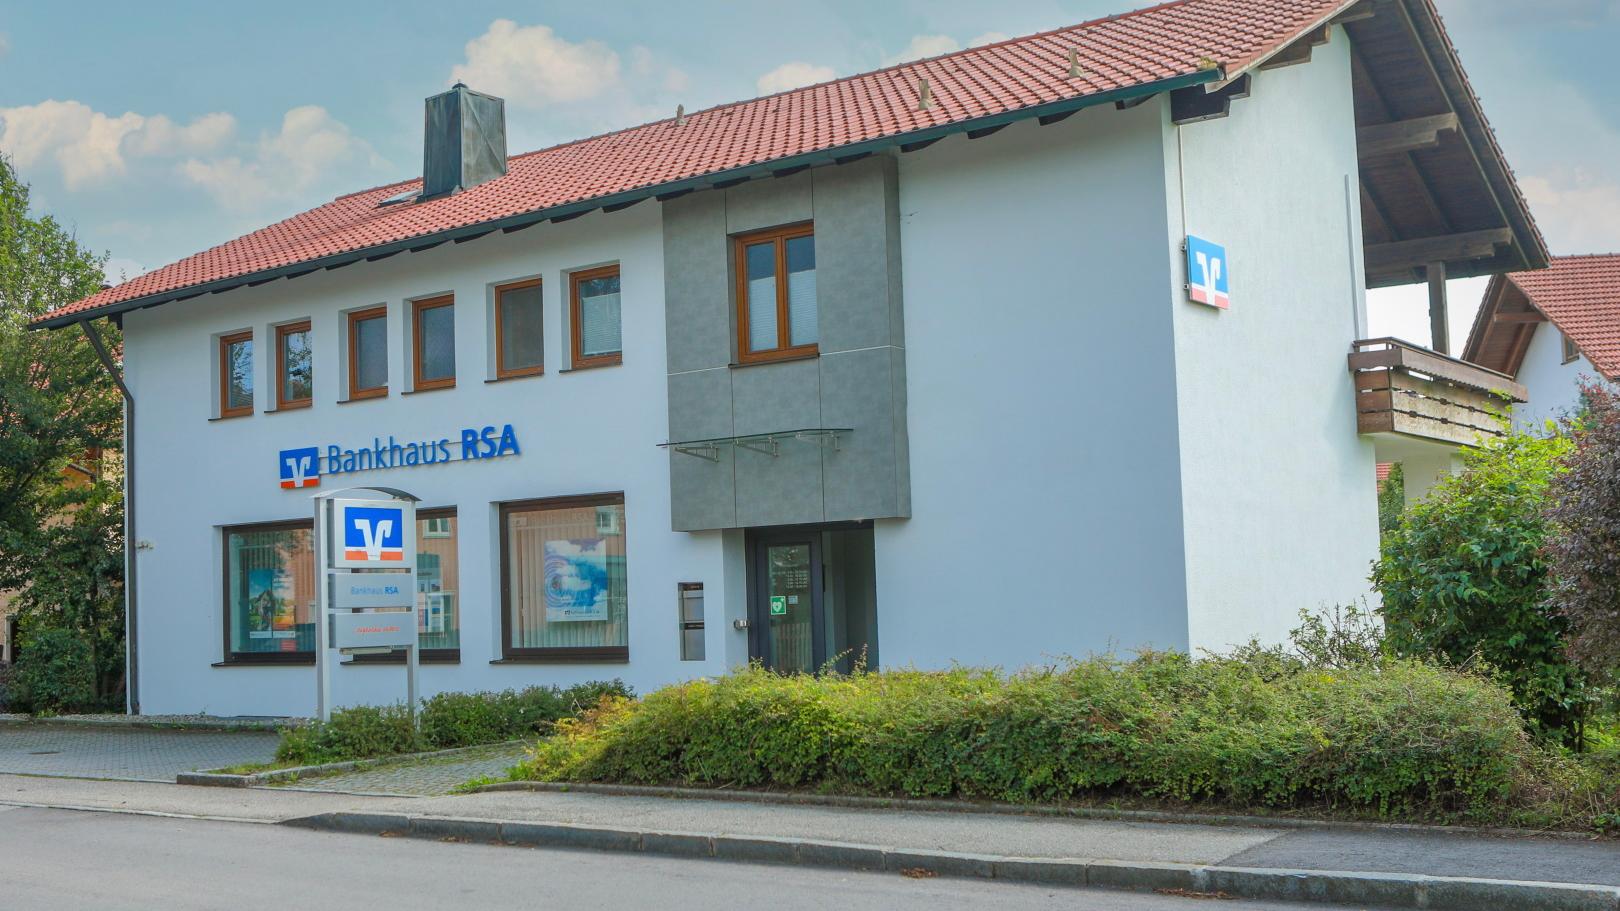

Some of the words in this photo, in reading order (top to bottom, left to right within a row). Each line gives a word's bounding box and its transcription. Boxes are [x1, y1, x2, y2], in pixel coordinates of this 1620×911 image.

[327, 436, 450, 474] Bankhaus
[461, 424, 521, 460] RSA
[384, 586, 399, 595] RSA
